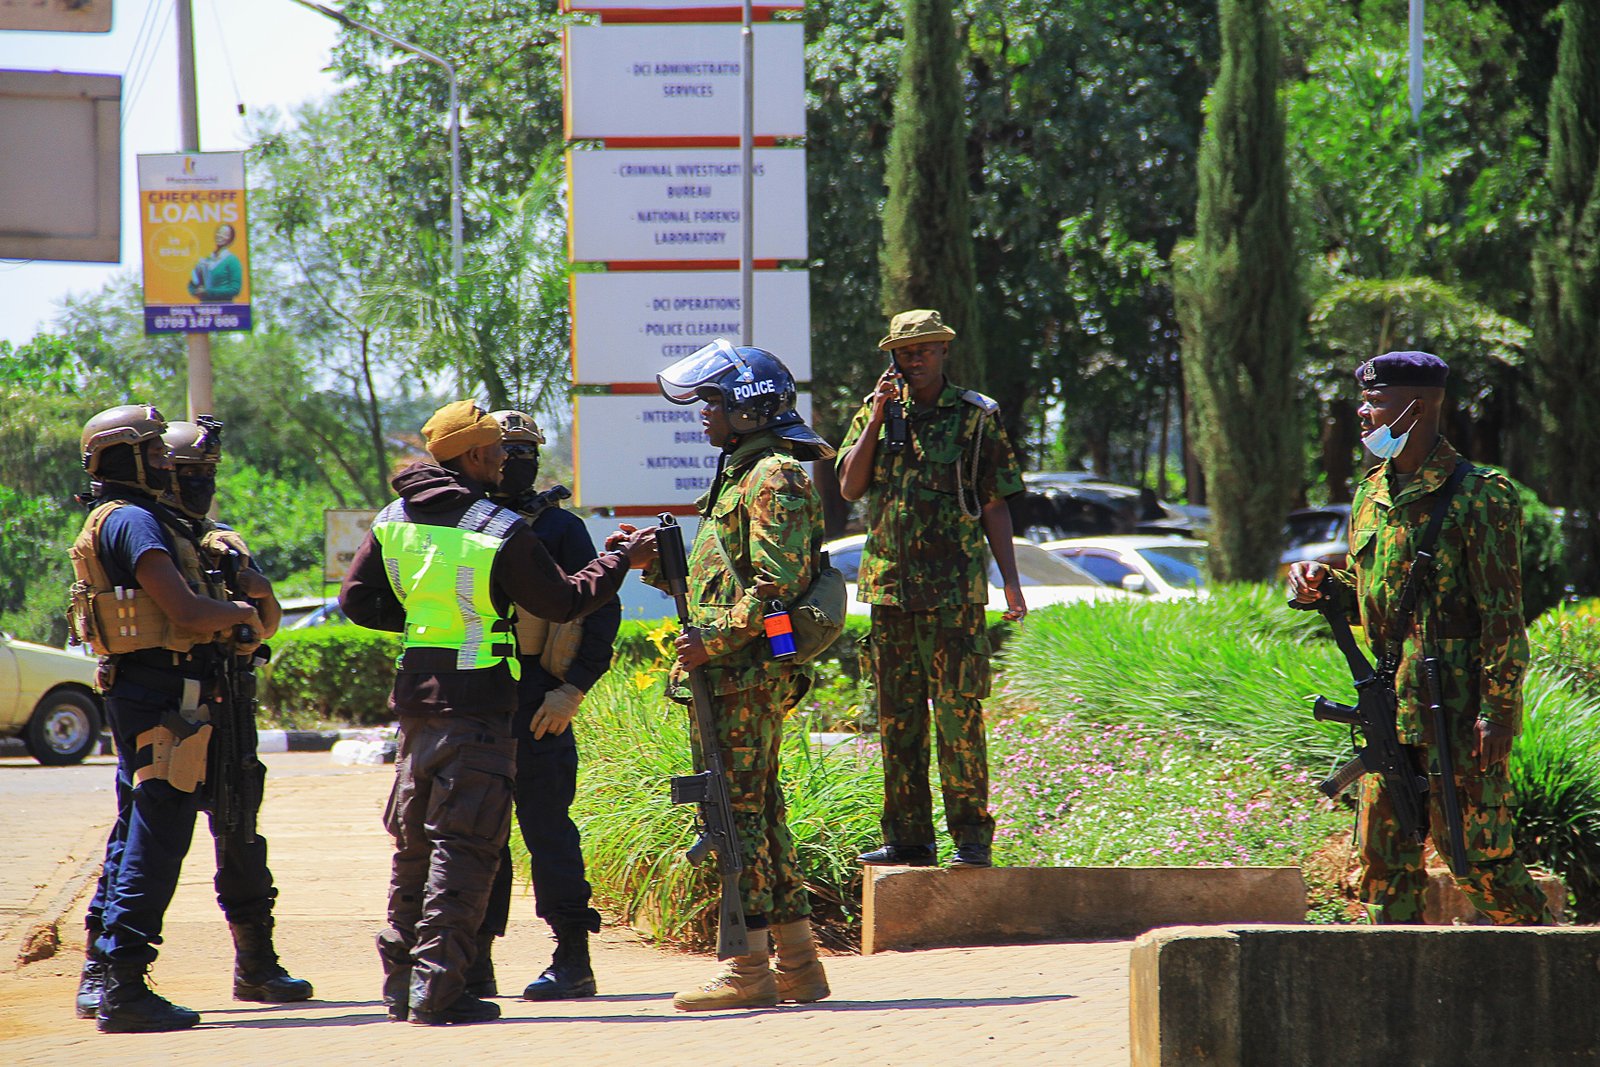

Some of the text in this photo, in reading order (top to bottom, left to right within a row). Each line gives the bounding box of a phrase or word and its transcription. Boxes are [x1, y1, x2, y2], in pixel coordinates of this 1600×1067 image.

[633, 63, 741, 75] DCI ADMINISTRATIO
[662, 85, 713, 97] SERVICES
[618, 164, 765, 177] CRIMINAL INVESTIGATINS
[148, 191, 237, 204] CHECK-OFF
[667, 186, 711, 198] BUREAU
[148, 203, 239, 224] LOANS
[637, 211, 741, 223] NATIONAL FORENSI
[654, 232, 726, 245] LABORATORY
[653, 298, 741, 311] DCI OPERATIONS
[645, 323, 741, 336] POLICE CLEARANC
[733, 380, 775, 400] POLICE
[643, 410, 695, 423] INTERPOL
[674, 431, 711, 444] BUREA
[646, 456, 701, 468] NATIONAL
[675, 477, 714, 490] BUREA
